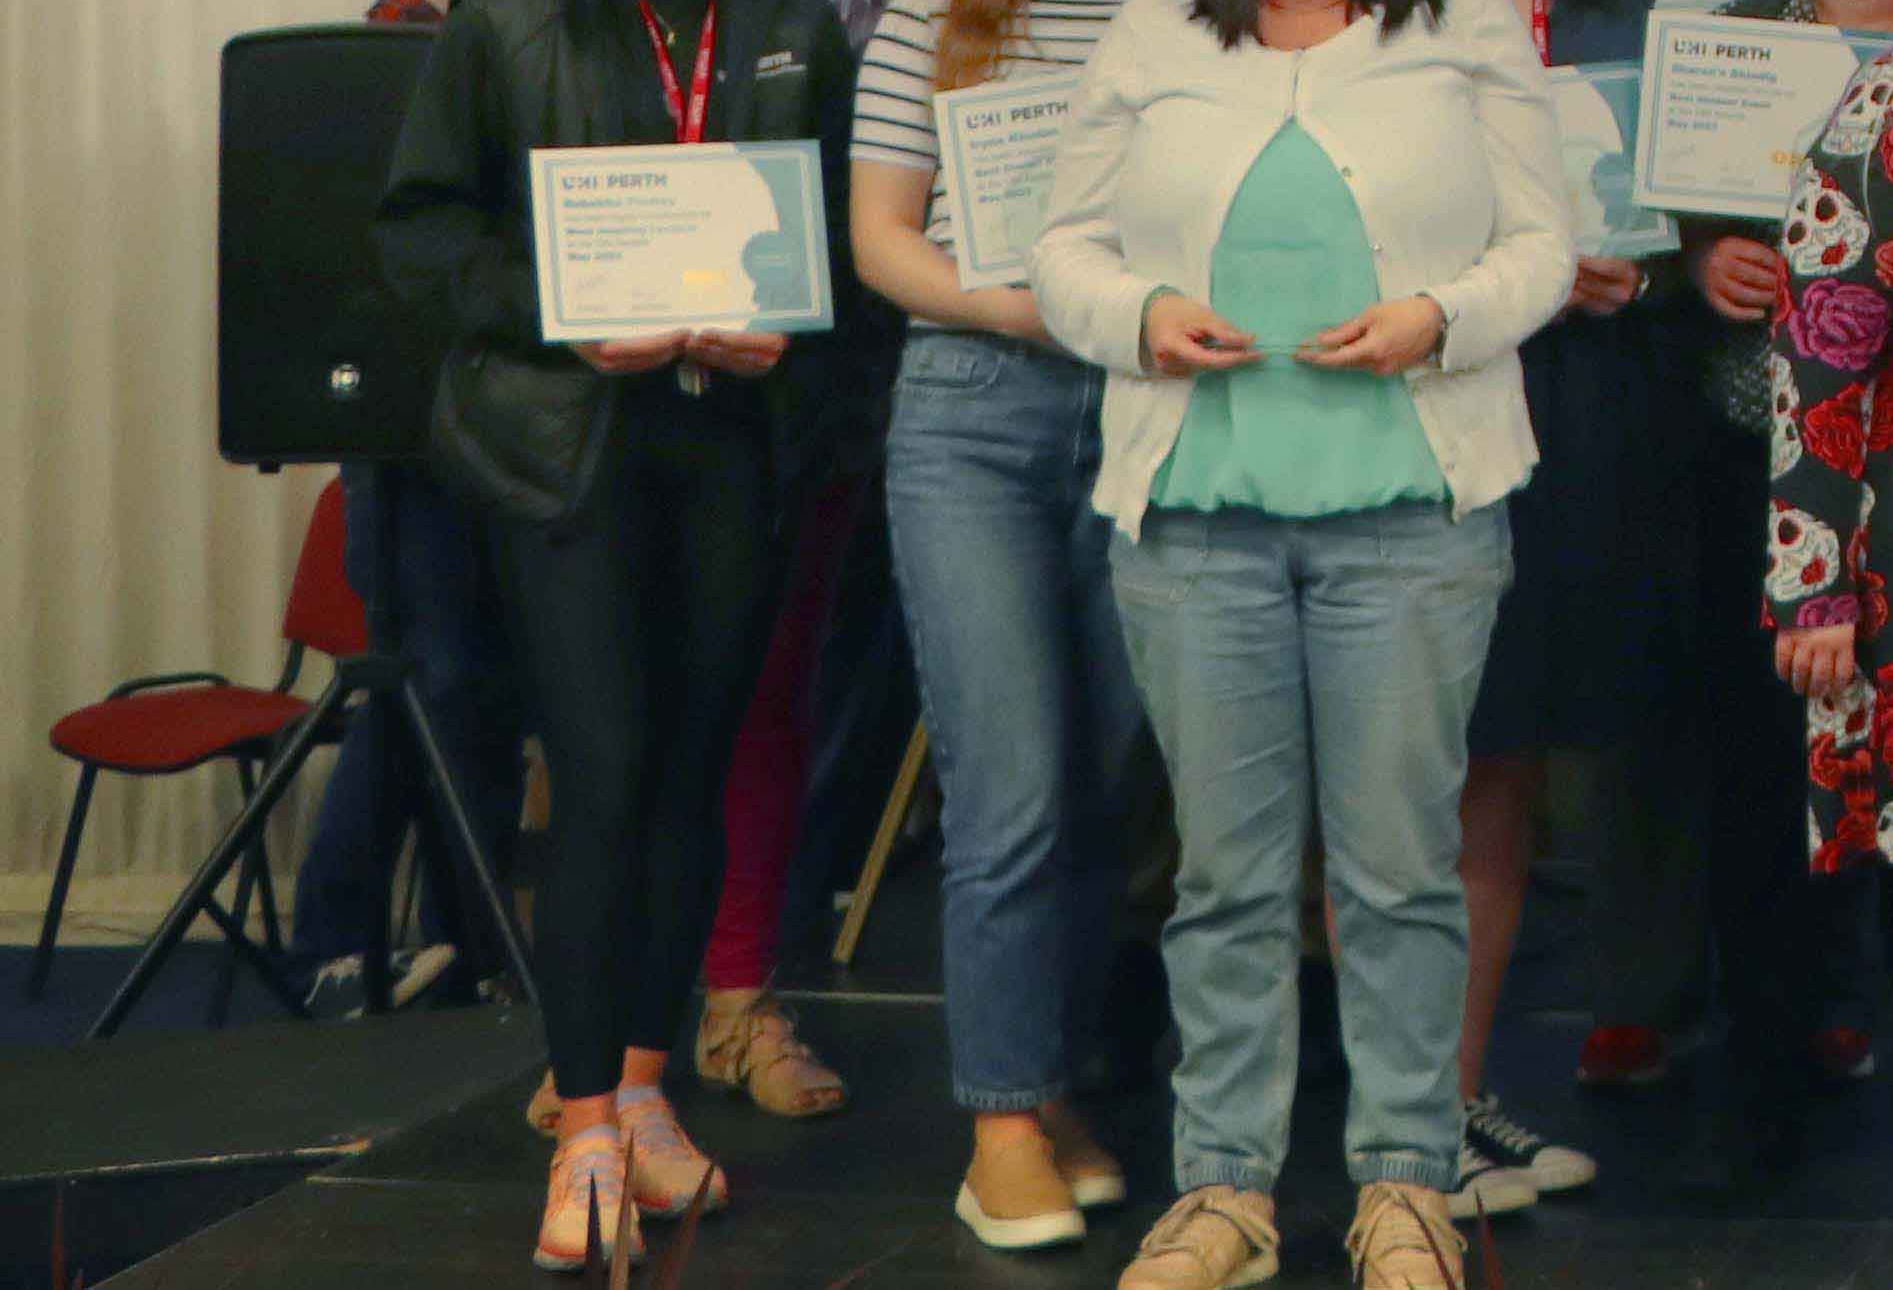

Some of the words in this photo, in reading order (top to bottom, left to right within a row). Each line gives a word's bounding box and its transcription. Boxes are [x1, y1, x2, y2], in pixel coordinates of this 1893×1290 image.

[1715, 43, 1772, 62] PERTH
[1009, 101, 1069, 121] PERTH
[606, 172, 669, 190] PERTH
